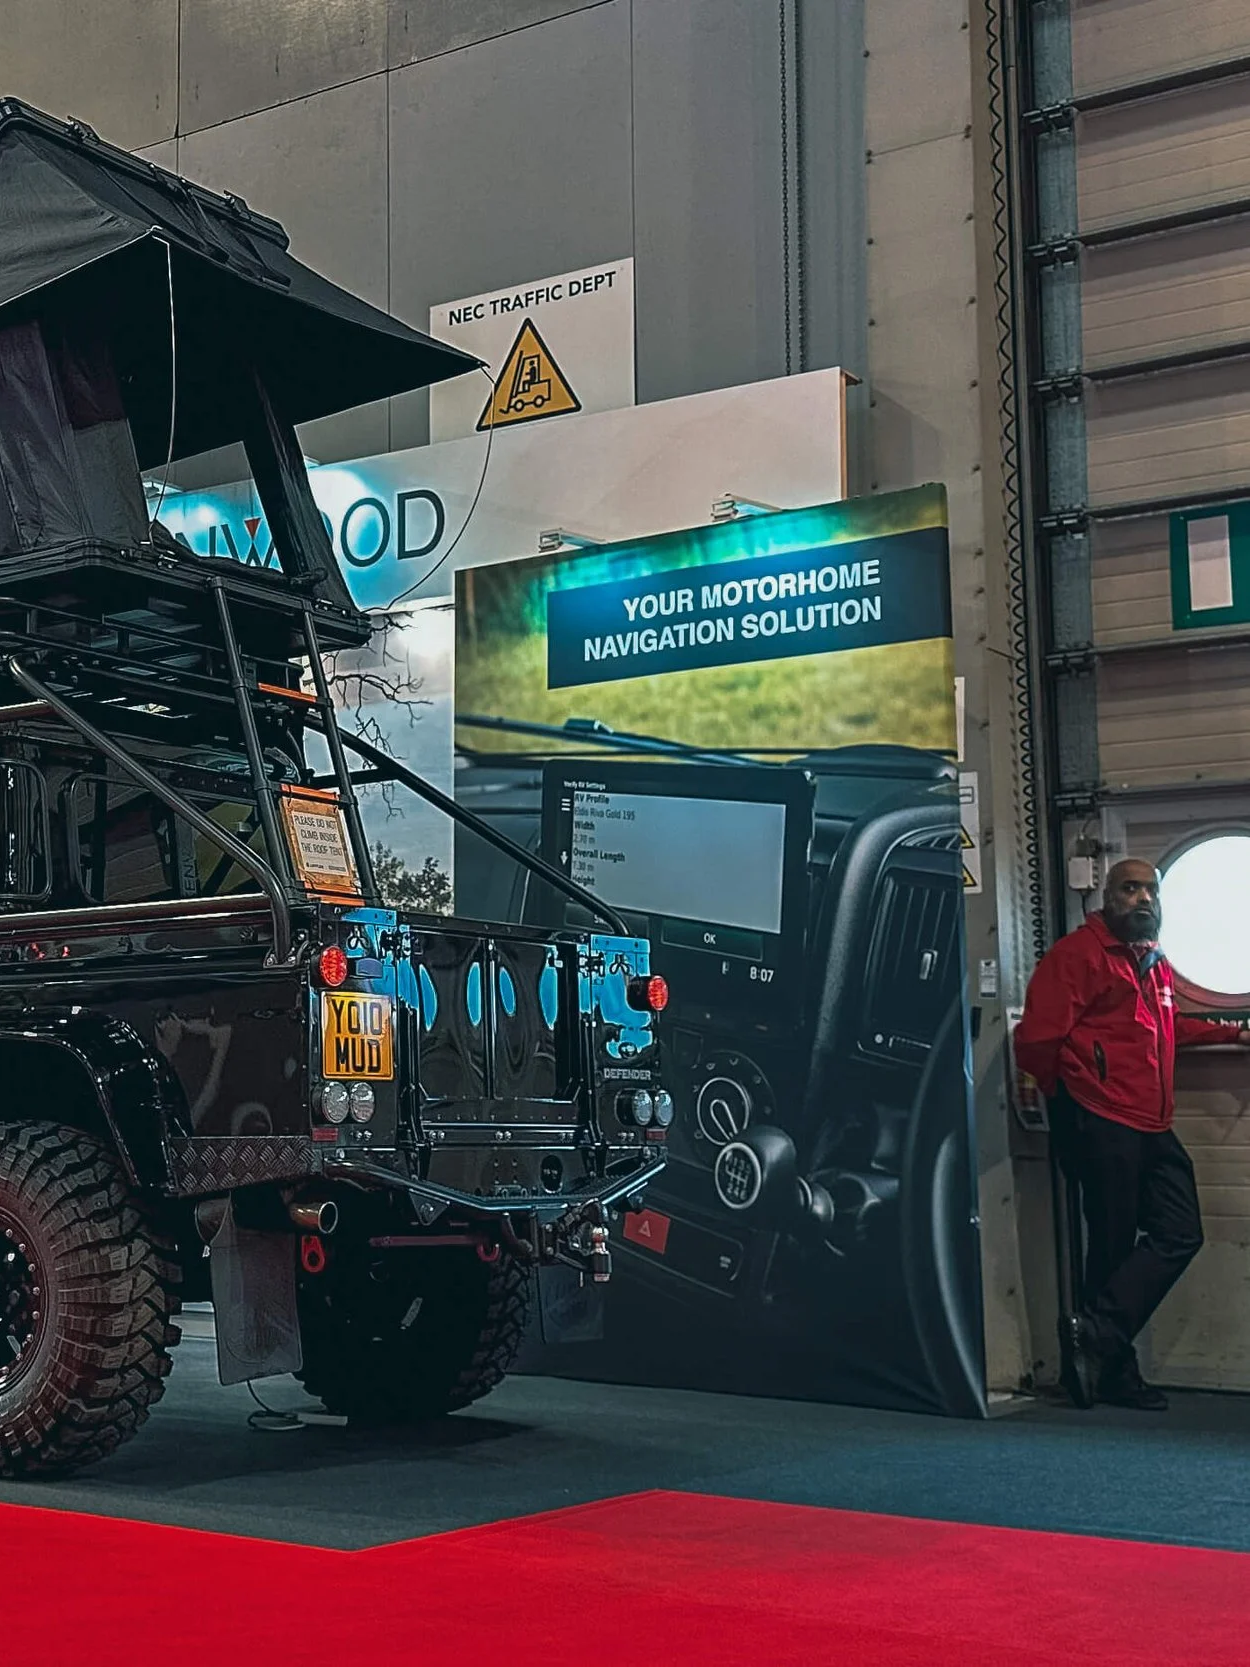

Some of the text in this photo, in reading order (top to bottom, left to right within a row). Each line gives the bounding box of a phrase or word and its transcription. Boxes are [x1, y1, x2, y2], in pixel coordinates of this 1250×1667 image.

[449, 271, 616, 326] NEC TRAFFIC DEPT
[623, 559, 880, 621] YOUR MOTORHOME
[584, 596, 881, 661] NAVIGATION SOLUTION
[587, 794, 610, 804] Profile
[294, 815, 337, 830] PLEASE DO NOT
[606, 810, 621, 820] Gold
[575, 820, 595, 830] Width
[301, 829, 338, 843] CLIMB INSIDE
[301, 842, 313, 853] THE
[313, 844, 328, 855] ROOF
[574, 848, 625, 863] Overall Length
[703, 932, 716, 944] OK
[750, 966, 774, 983] 8:07
[331, 999, 382, 1036] YO10
[335, 1036, 381, 1073] MUD
[603, 1067, 651, 1080] DEFENDER
